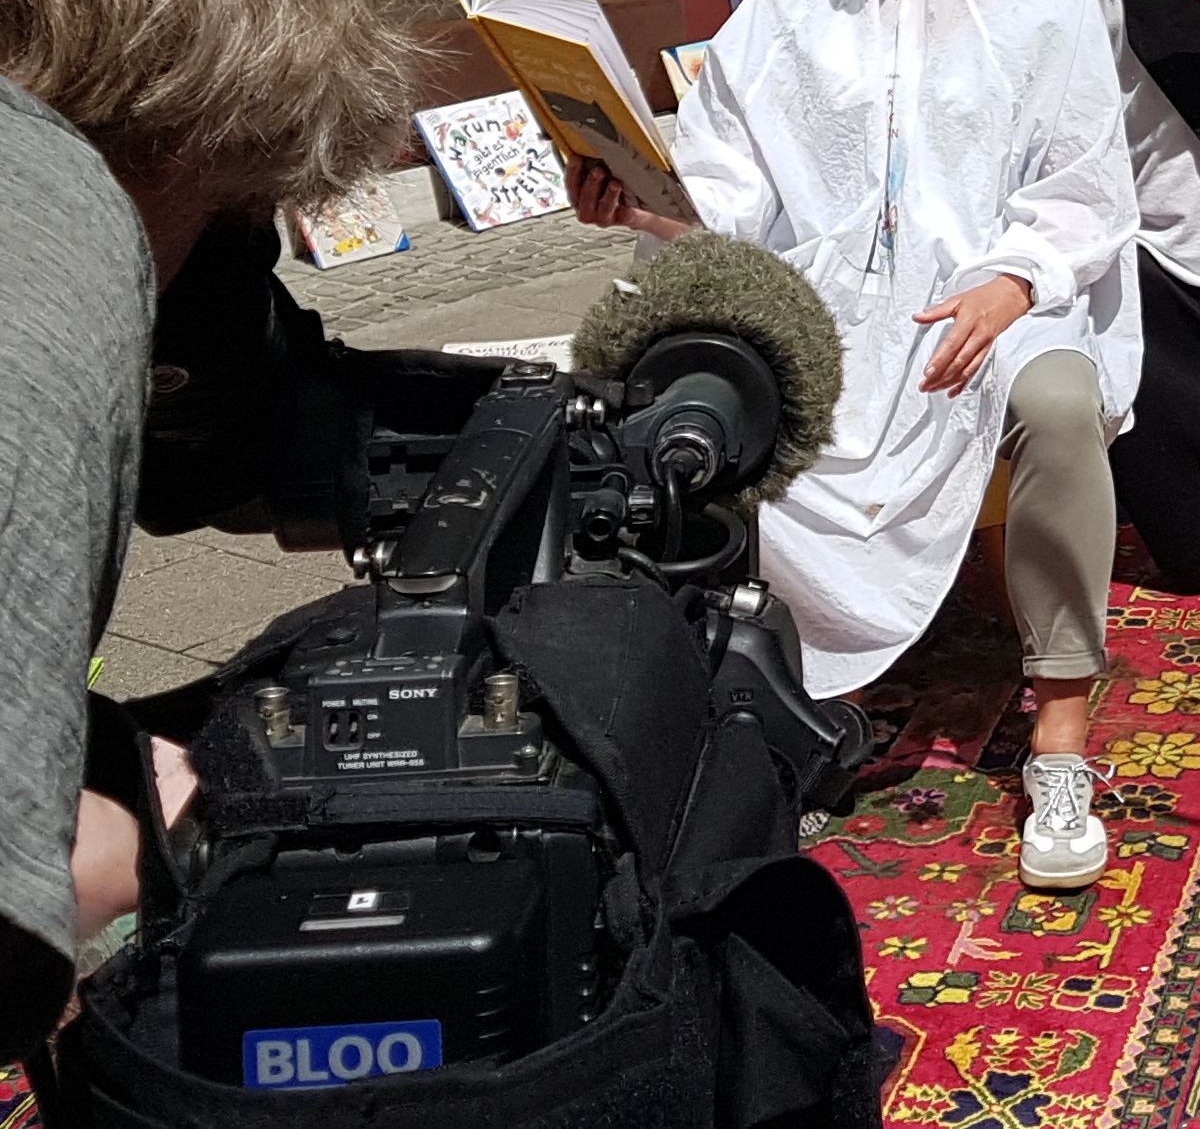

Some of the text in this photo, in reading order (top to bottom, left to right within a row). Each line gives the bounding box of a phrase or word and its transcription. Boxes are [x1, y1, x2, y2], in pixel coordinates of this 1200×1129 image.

[388, 688, 438, 700] SONY
[362, 750, 418, 760] SYNTHESIZED
[366, 760, 386, 769] UNIT
[256, 1032, 423, 1085] BLOO
